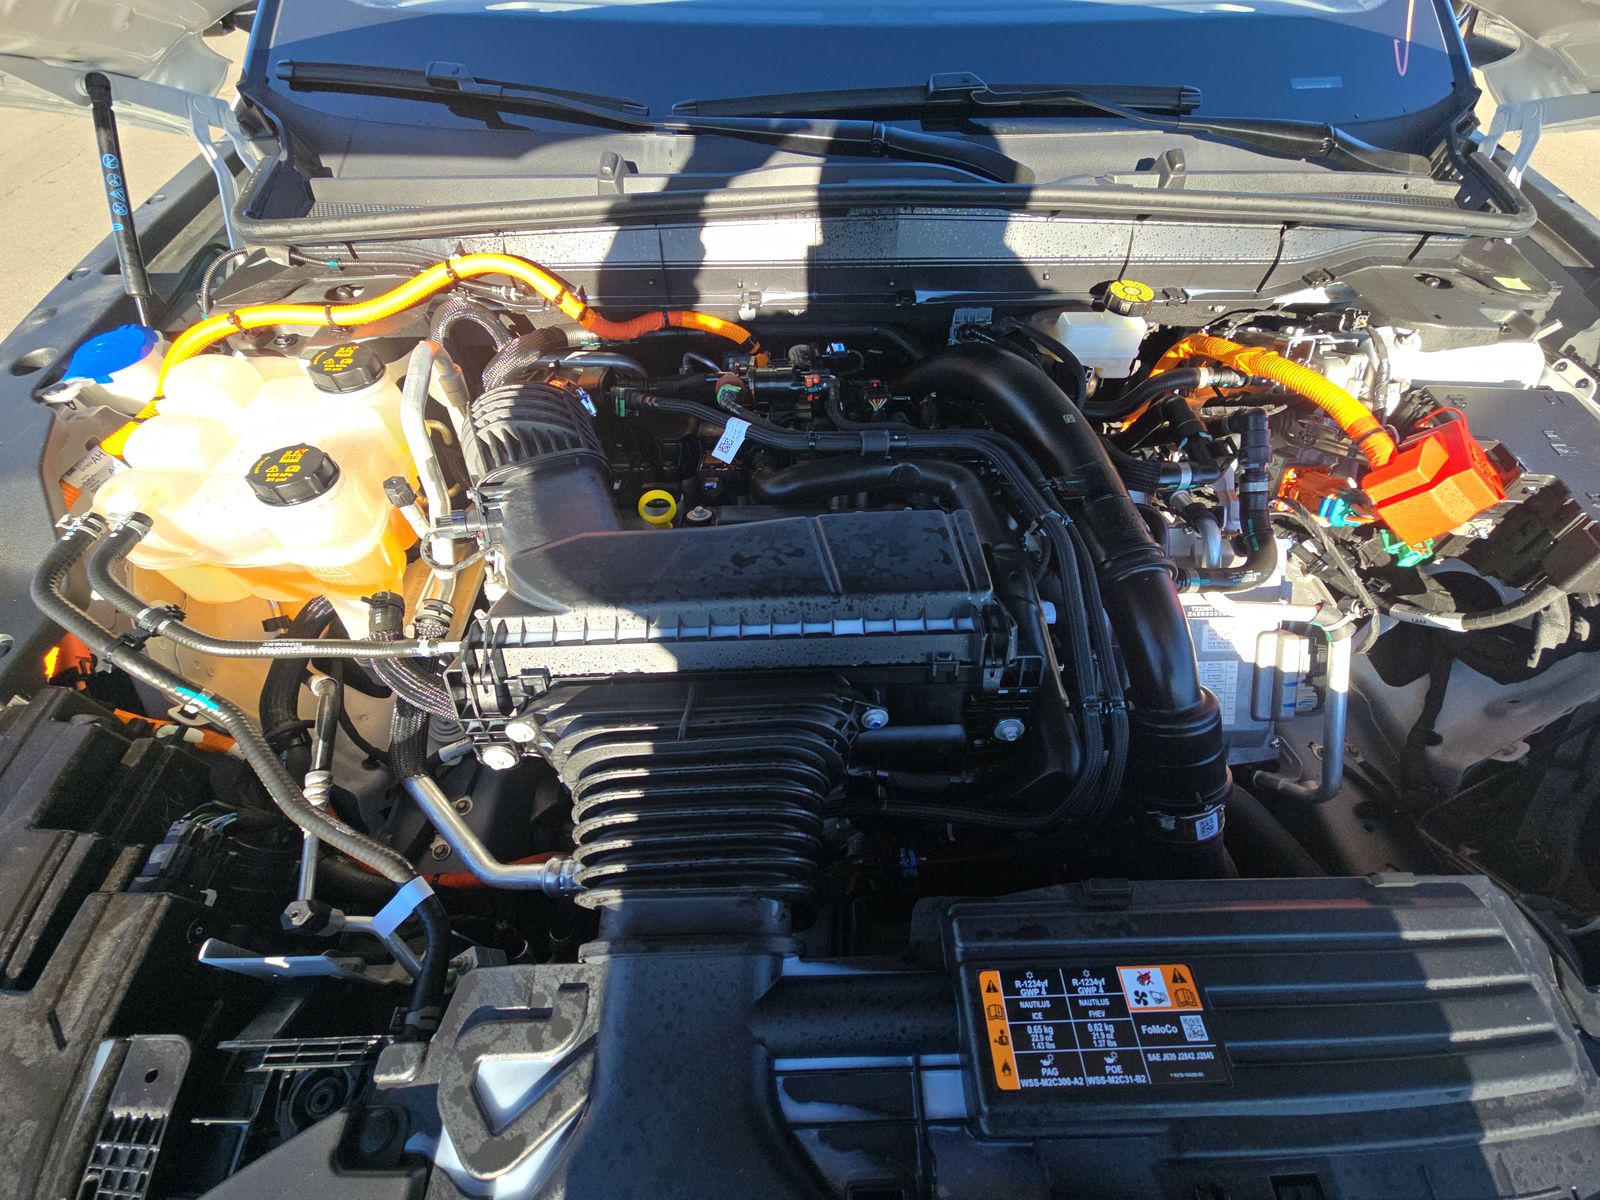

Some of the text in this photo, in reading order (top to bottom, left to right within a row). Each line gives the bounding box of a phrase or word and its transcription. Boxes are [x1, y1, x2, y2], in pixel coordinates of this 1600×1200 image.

[1014, 979, 1048, 990] R-1234yf
[1072, 977, 1105, 988] R-1234yf
[1077, 986, 1097, 994] GWP
[1020, 1000, 1051, 1008] NAUTILUS
[1027, 1025, 1054, 1036] 0.65 kg
[1087, 1023, 1114, 1034] 0.62 kg
[1141, 1024, 1178, 1034] FoMoCo
[1147, 1052, 1161, 1062] SAE
[1041, 1068, 1059, 1076] PAG
[1105, 1065, 1123, 1074] POE
